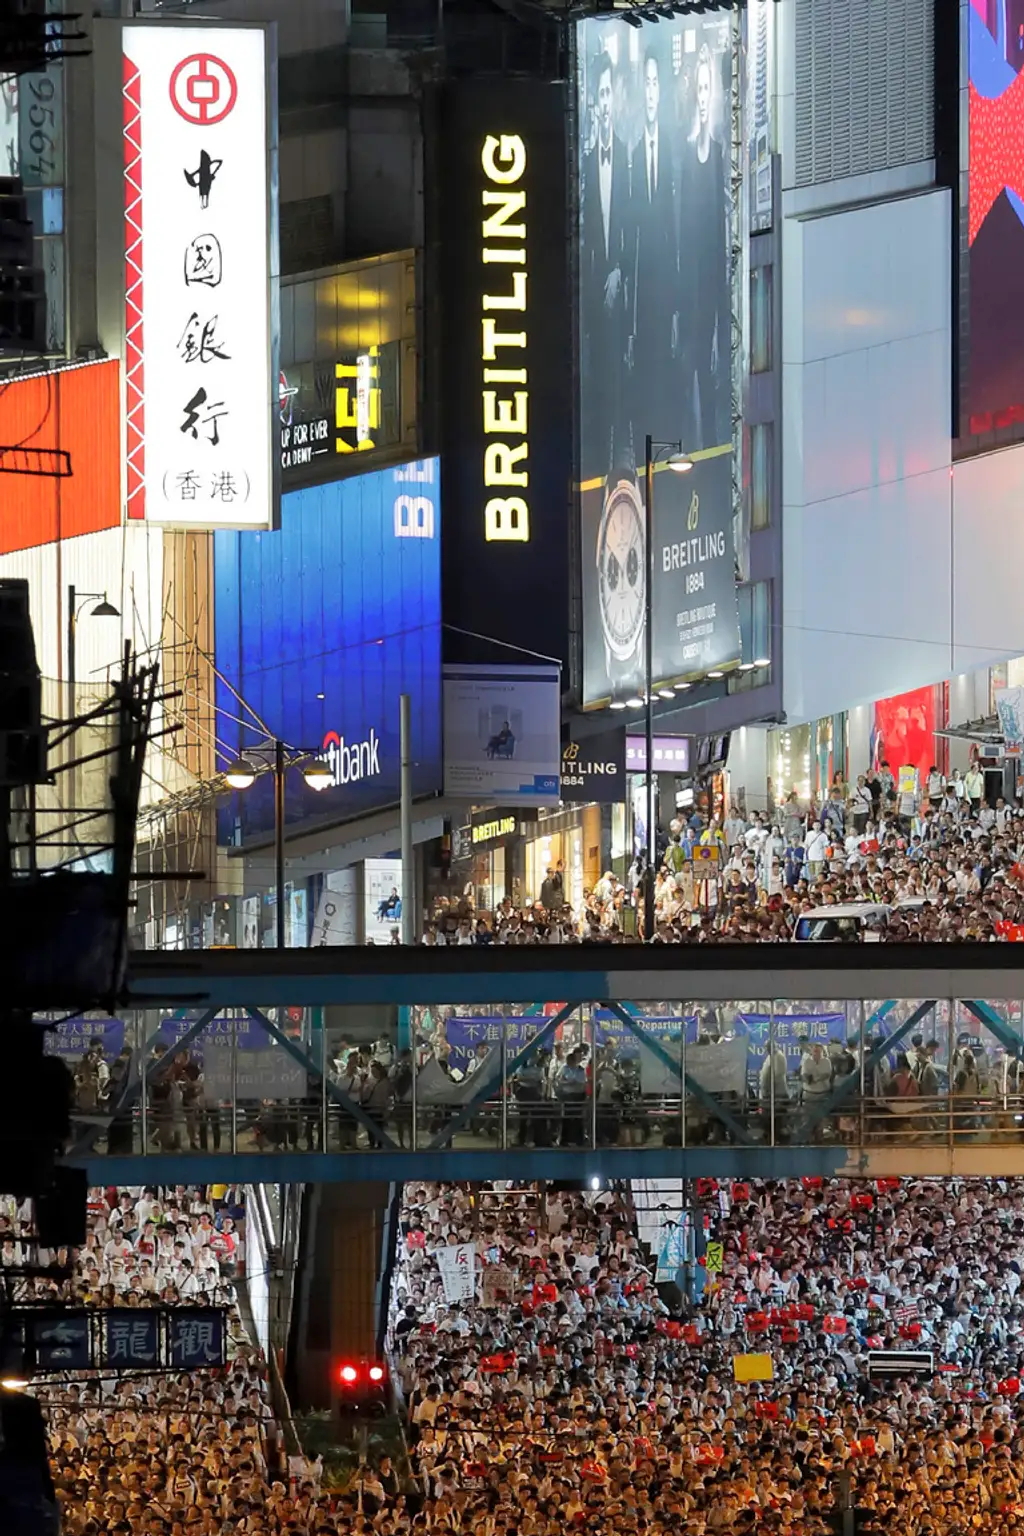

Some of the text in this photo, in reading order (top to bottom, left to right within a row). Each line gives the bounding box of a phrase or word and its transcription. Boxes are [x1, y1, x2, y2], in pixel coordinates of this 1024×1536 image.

[176, 149, 232, 446] 中國銀行
[482, 133, 530, 543] BREITLING
[281, 419, 329, 448] UP FOR EVER
[281, 446, 312, 468] CADEMY
[662, 531, 725, 572] BREITLING
[686, 572, 704, 595] 1884
[561, 762, 618, 775] ITLING
[472, 816, 515, 843] BREITLING
[454, 1046, 475, 1059] No
